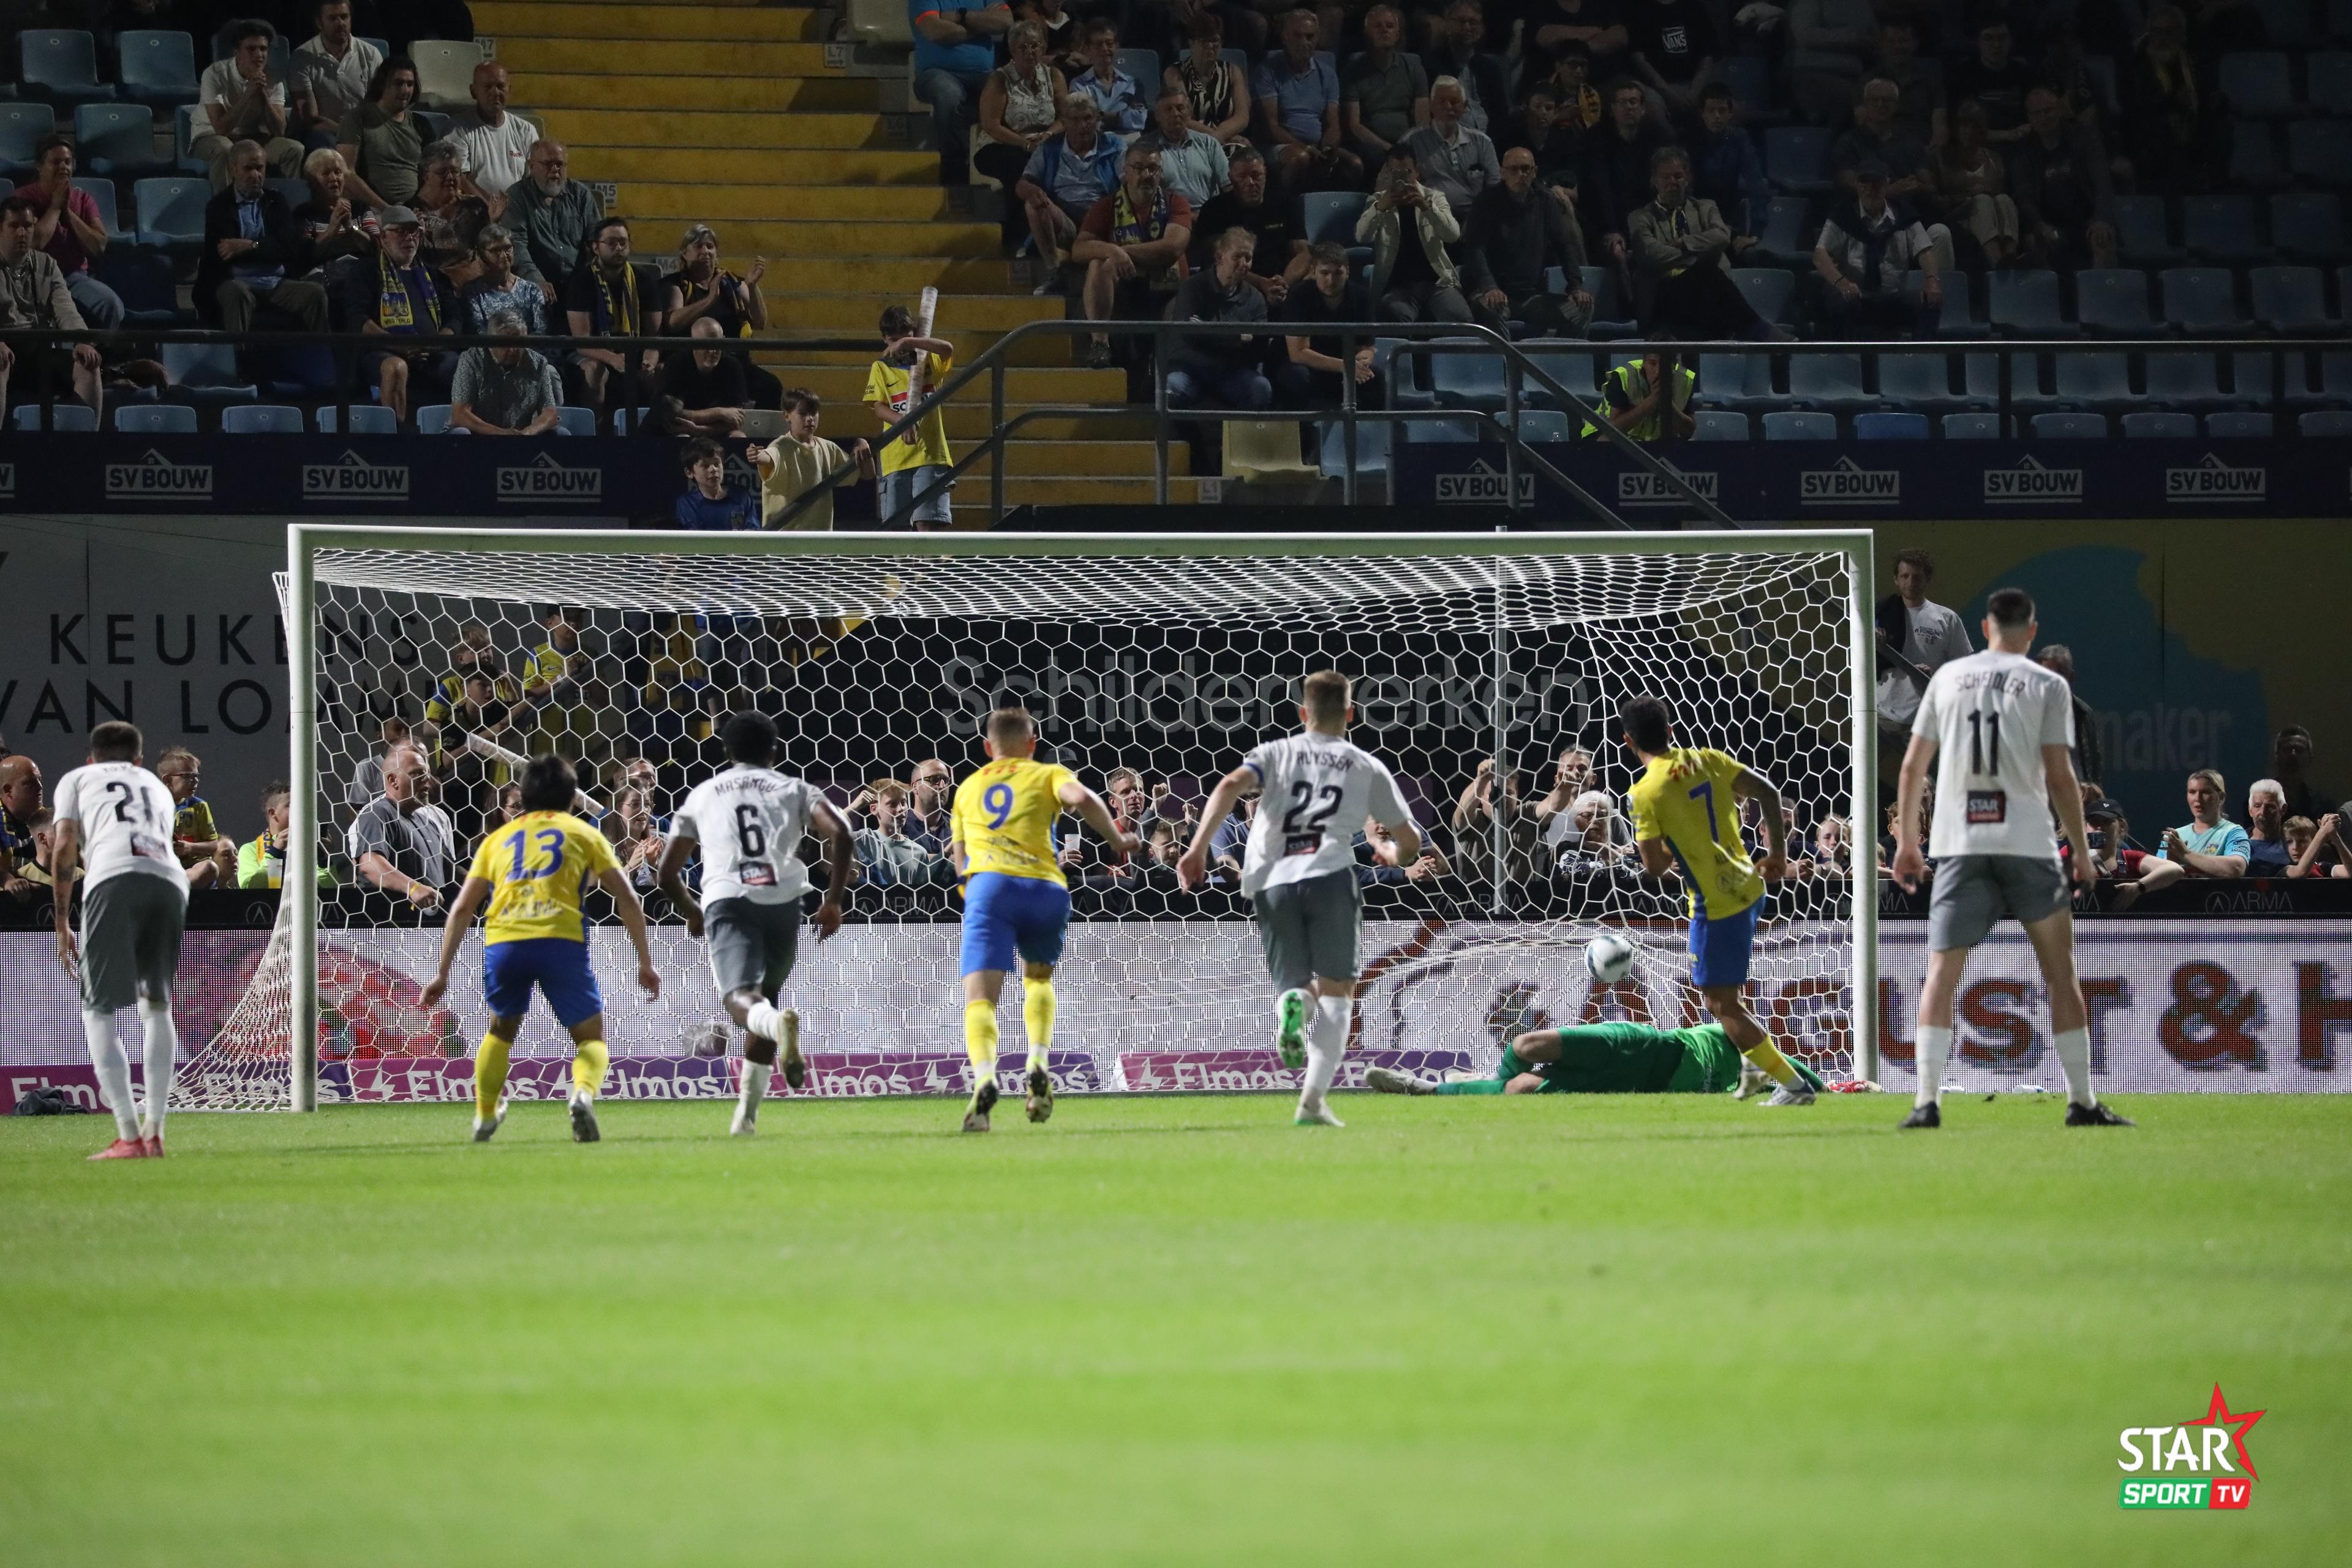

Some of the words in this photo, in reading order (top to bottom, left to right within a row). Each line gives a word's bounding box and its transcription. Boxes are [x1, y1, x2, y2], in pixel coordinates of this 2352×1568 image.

[1665, 29, 1687, 49] VANS
[597, 185, 616, 197] M5
[109, 469, 139, 489] SV
[142, 469, 208, 489] BOUW
[307, 469, 334, 489] SV
[339, 469, 404, 489] BOUW
[500, 470, 529, 491] SV
[532, 470, 597, 491] BOUW
[1440, 476, 1466, 497] SV
[1470, 476, 1531, 497] BOUW
[1623, 475, 1649, 496] SV
[1804, 473, 1831, 494] SV
[1835, 473, 1895, 494] BOUW
[1988, 472, 2014, 492] SV
[2021, 472, 2078, 492] BOUW
[2169, 470, 2196, 491] SV
[2200, 470, 2262, 491] BOUW
[943, 655, 1588, 733] Schildererken
[1968, 708, 2000, 777] 11
[107, 782, 153, 823] 21
[983, 783, 1014, 830] 9
[1282, 780, 1343, 834] 22
[1688, 780, 1720, 843] 7
[1969, 799, 1999, 812] STAR
[736, 804, 766, 858] 6
[504, 829, 565, 883] 13
[880, 896, 941, 915] ARMA
[2231, 891, 2294, 911] ARMA
[2160, 959, 2268, 1074] &
[203, 1072, 340, 1101] Elms
[597, 1069, 722, 1098] Elmos
[790, 1068, 912, 1096] lmos
[1173, 1063, 1297, 1090] Elmos
